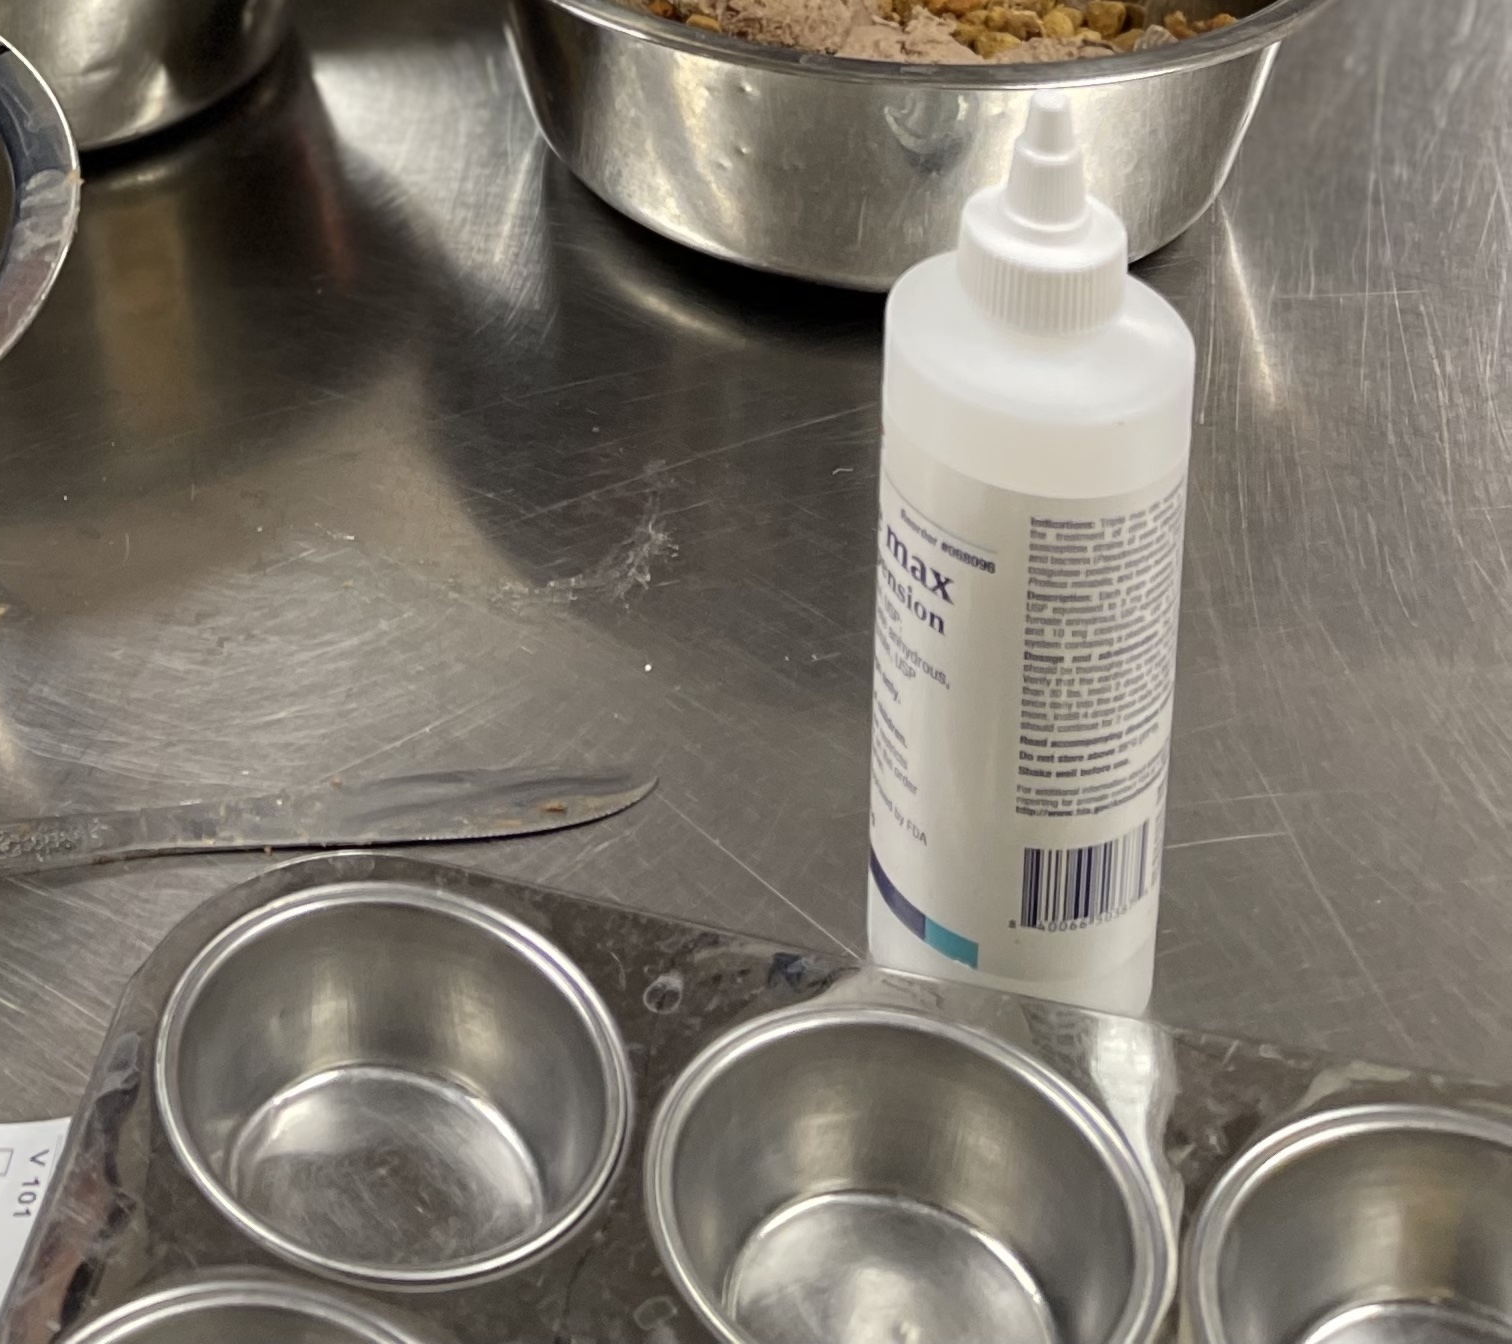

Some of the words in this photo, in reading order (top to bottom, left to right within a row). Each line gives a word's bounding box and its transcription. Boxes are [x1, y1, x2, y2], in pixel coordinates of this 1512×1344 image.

[886, 524, 955, 606] max
[876, 558, 946, 637] ension
[28, 1148, 51, 1167] V
[12, 1179, 41, 1219] 101
